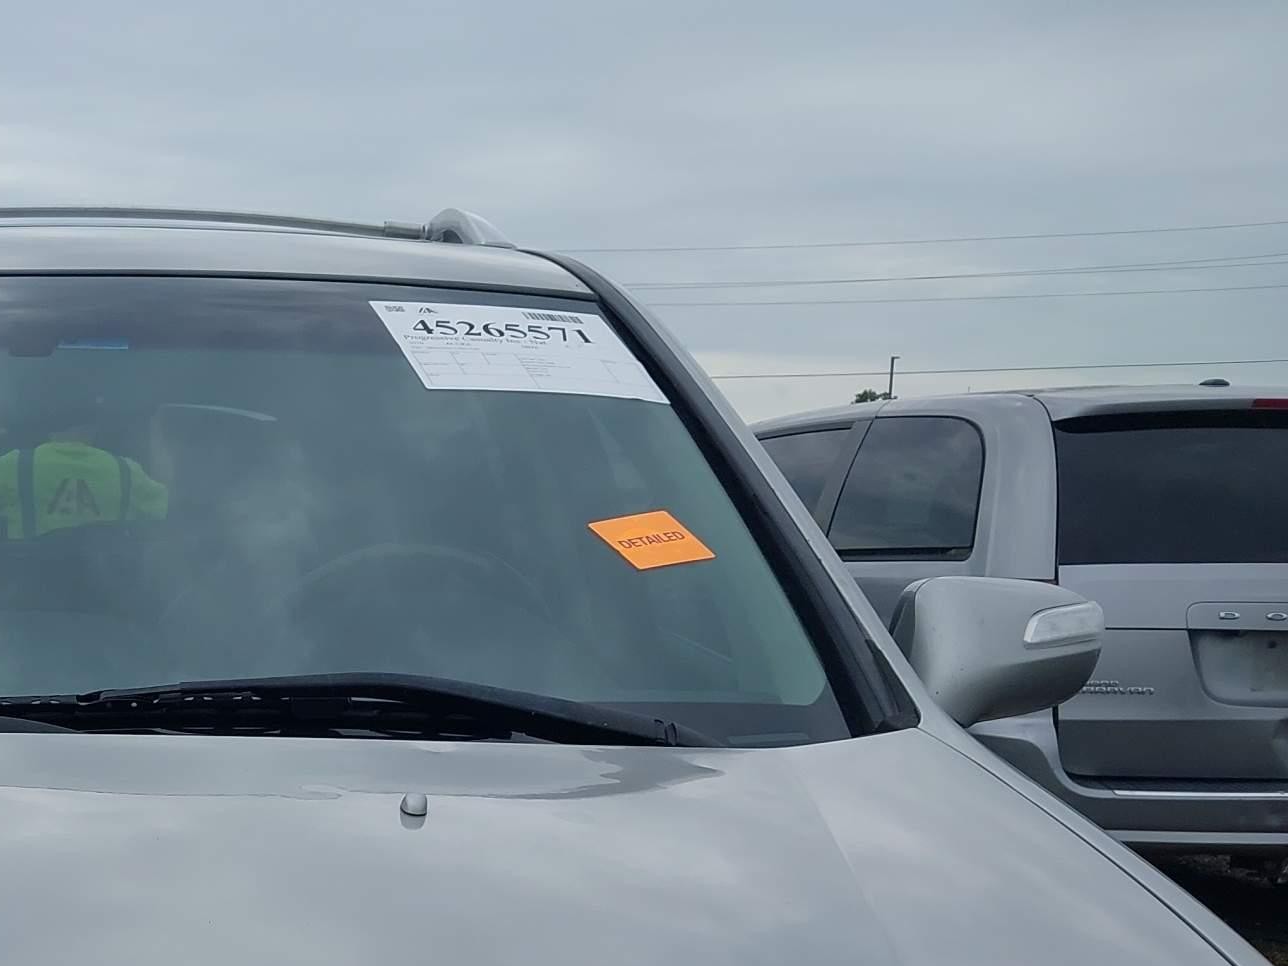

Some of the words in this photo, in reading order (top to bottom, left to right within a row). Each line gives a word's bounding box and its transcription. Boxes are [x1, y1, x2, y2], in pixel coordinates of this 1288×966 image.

[412, 319, 593, 344] 45265571
[617, 531, 686, 549] DETAILED
[1080, 686, 1155, 695] ARAVAN
